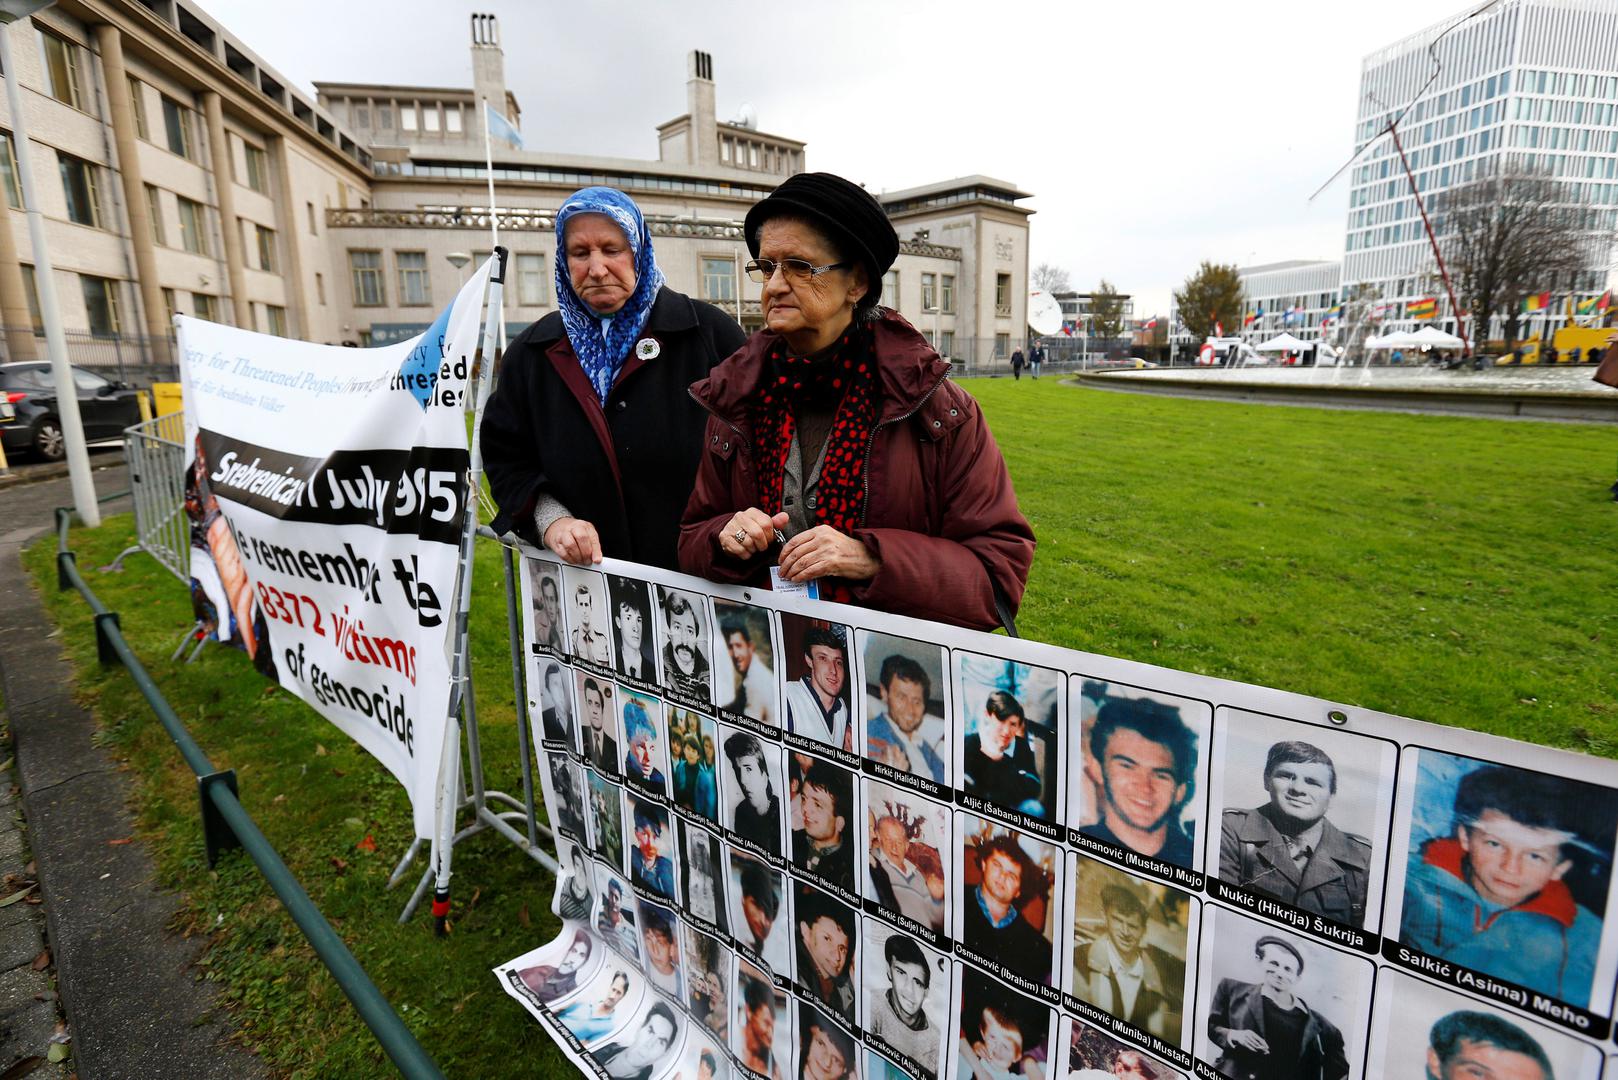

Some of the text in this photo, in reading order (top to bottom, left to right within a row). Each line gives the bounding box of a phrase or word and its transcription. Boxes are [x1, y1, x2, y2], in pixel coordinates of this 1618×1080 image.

[327, 465, 390, 526] July
[250, 543, 382, 604] remembr
[257, 581, 325, 636] 8372
[285, 643, 413, 758] of genocide
[721, 710, 736, 722] Mujić
[784, 732, 860, 766] Mustafić (Selman) Nedžad
[874, 763, 938, 794] Hirkić (Halida) Beriz
[963, 795, 1057, 837] Aljić (Šabana) Nermin
[1070, 831, 1202, 887] Džananović (Mustafe) Mujo
[819, 877, 840, 895] (Nezira)
[840, 888, 860, 904] Osman
[1219, 884, 1364, 946] Nukić (Hikrija) Šukrija
[878, 907, 936, 943] Hirkić (Sulje) Halid
[955, 944, 1060, 1002] Osmanović (Ibrahim) Ibro
[1399, 948, 1590, 1029] Salkić (Asima) Meho
[866, 1035, 920, 1079] Duraković (Alija)
[1063, 996, 1191, 1067] Muminović (Muniba) Mustafa
